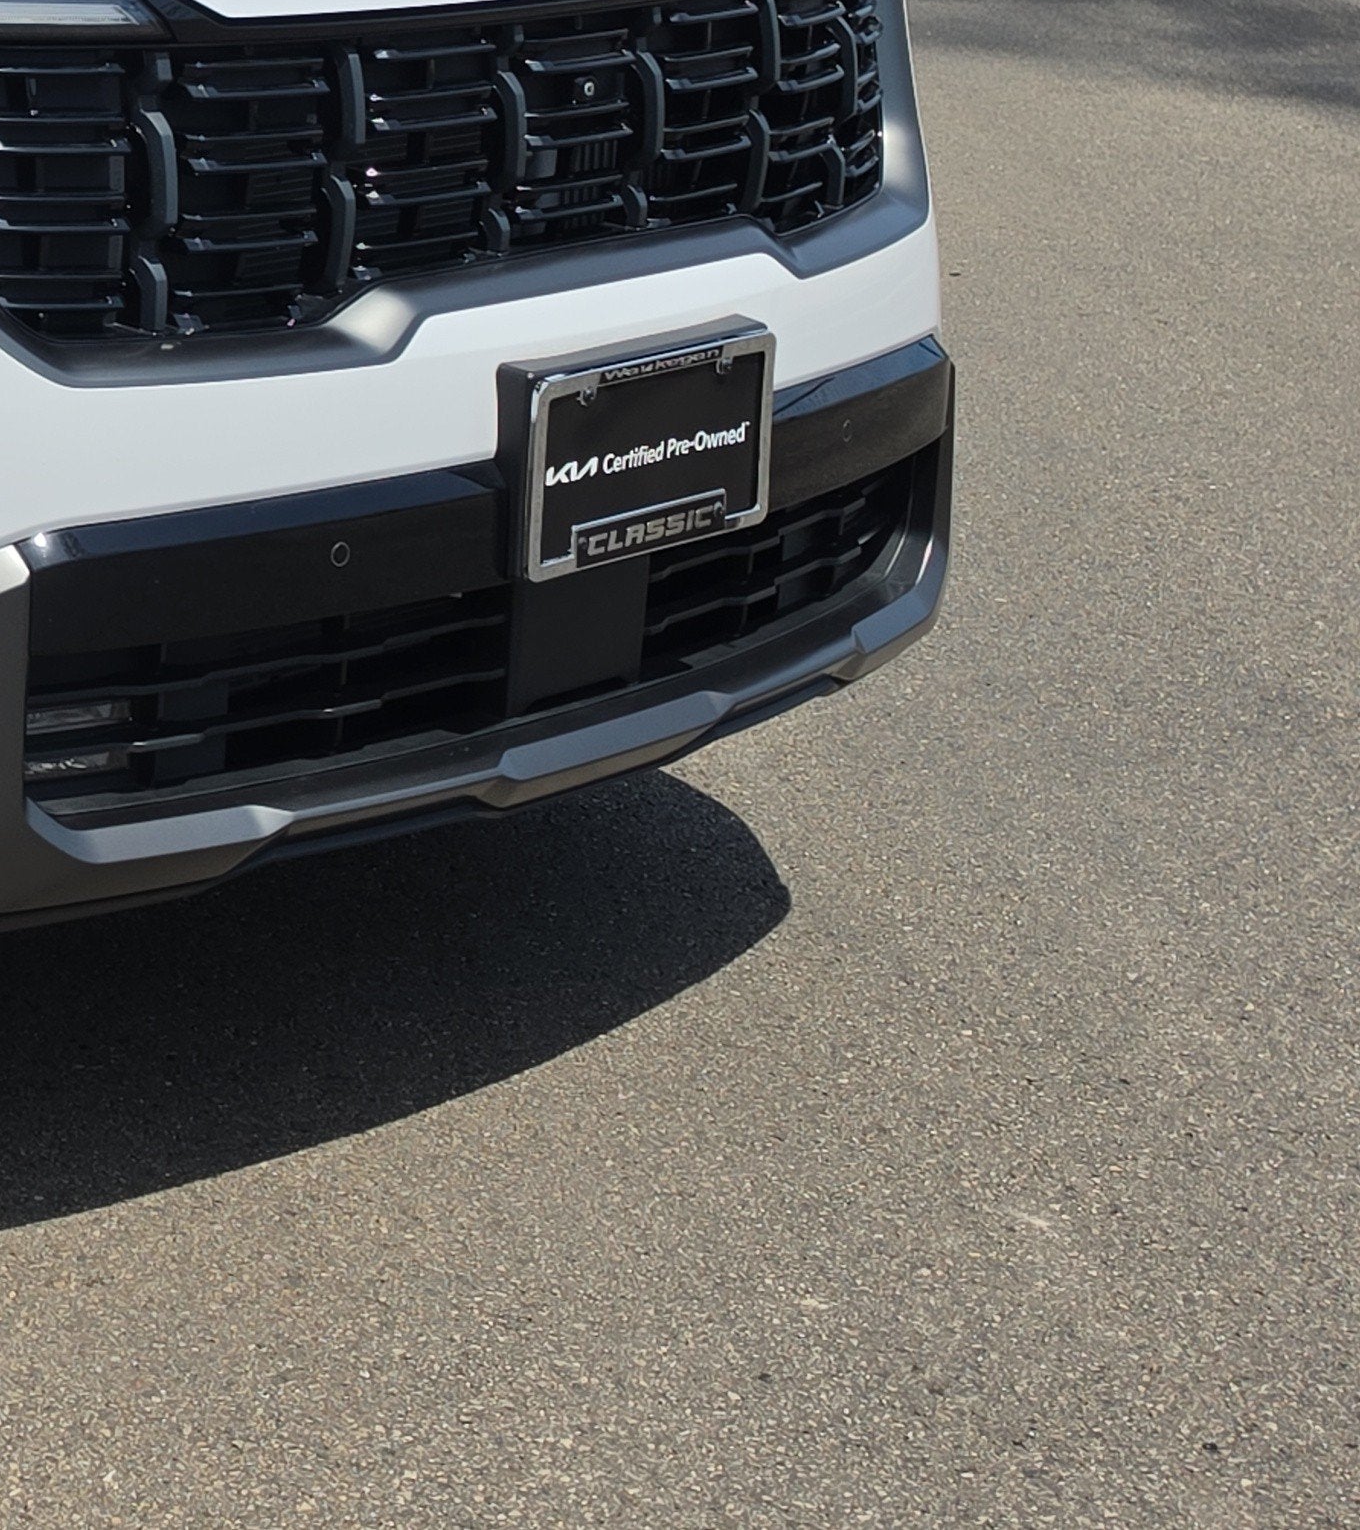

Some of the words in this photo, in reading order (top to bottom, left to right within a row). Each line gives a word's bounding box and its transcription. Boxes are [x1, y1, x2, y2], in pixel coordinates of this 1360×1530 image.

[545, 456, 598, 486] KIA
[603, 440, 665, 474] Certified
[666, 421, 747, 459] Pre-Owned
[587, 504, 714, 557] CLASSIC
